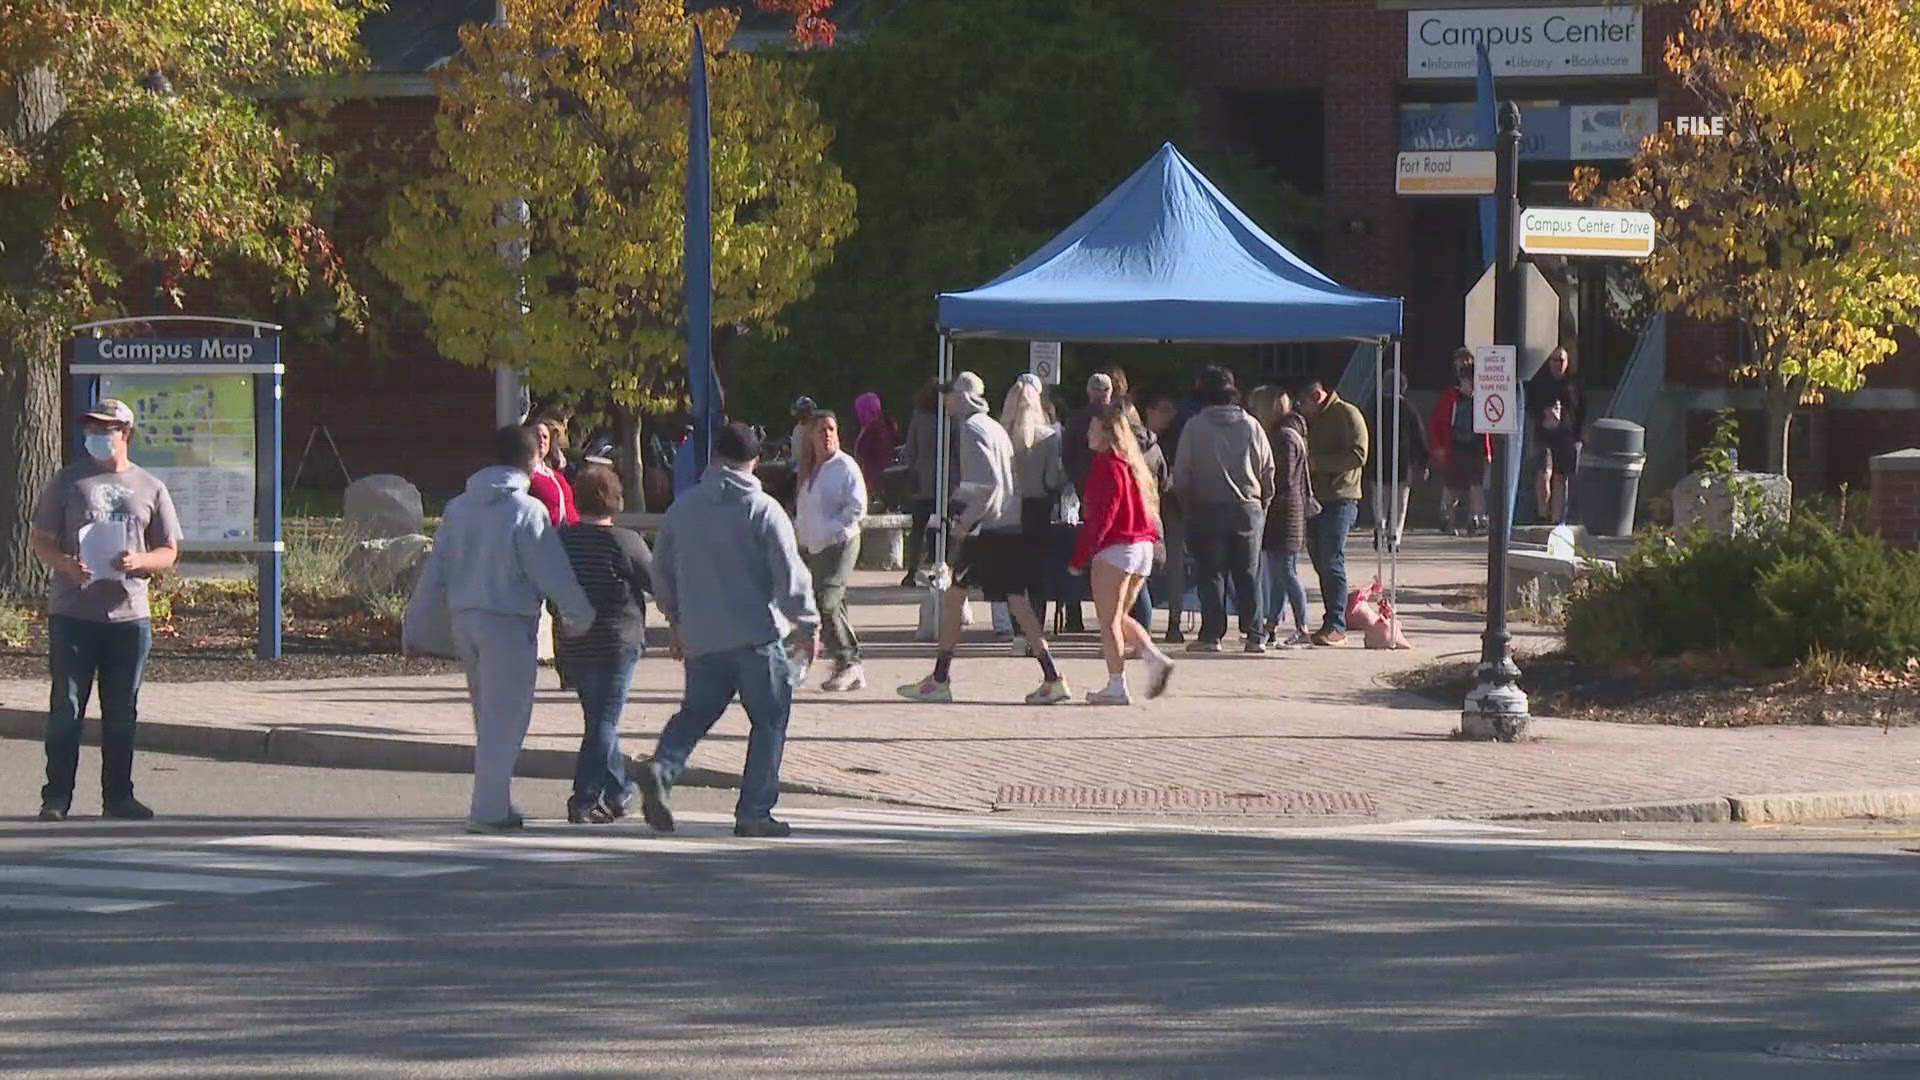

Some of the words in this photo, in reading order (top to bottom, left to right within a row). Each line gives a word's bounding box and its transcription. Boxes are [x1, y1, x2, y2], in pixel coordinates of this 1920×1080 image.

[1420, 18, 1533, 51] Campus
[1543, 15, 1635, 44] Center
[1511, 56, 1552, 70] Library
[1571, 54, 1630, 66] Bookstore
[1400, 157, 1419, 173] Fort
[1424, 156, 1452, 173] Road
[1525, 214, 1572, 234] Campus
[1577, 216, 1615, 233] Center
[1620, 218, 1651, 234] Drive
[98, 338, 193, 363] Campus
[200, 338, 253, 363] Map
[1479, 374, 1505, 382] TOBACCO
